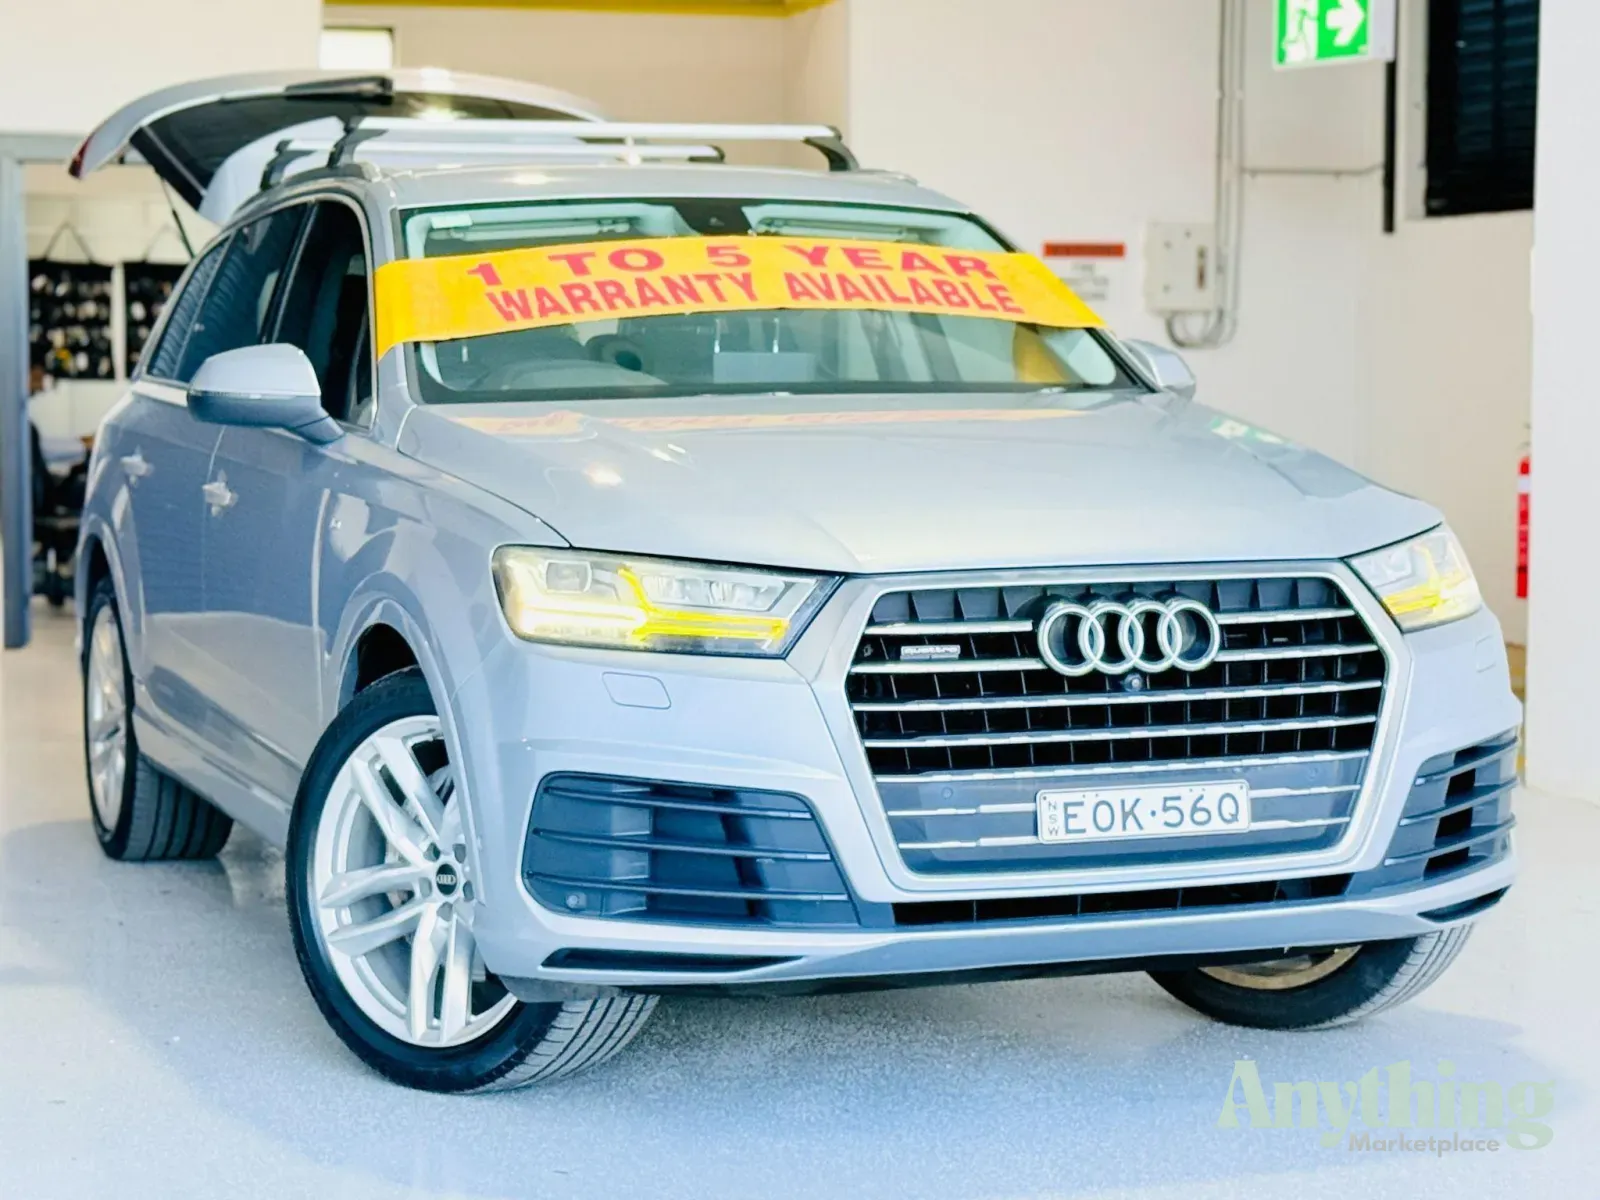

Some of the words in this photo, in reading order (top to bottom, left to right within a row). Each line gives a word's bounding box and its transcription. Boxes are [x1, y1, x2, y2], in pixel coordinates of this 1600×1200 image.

[467, 262, 502, 286] 1
[548, 248, 664, 277] TO
[706, 245, 751, 268] 5
[783, 245, 999, 280] YEAR
[485, 272, 758, 323] WARRANTY
[784, 272, 1026, 314] AVAILABLE
